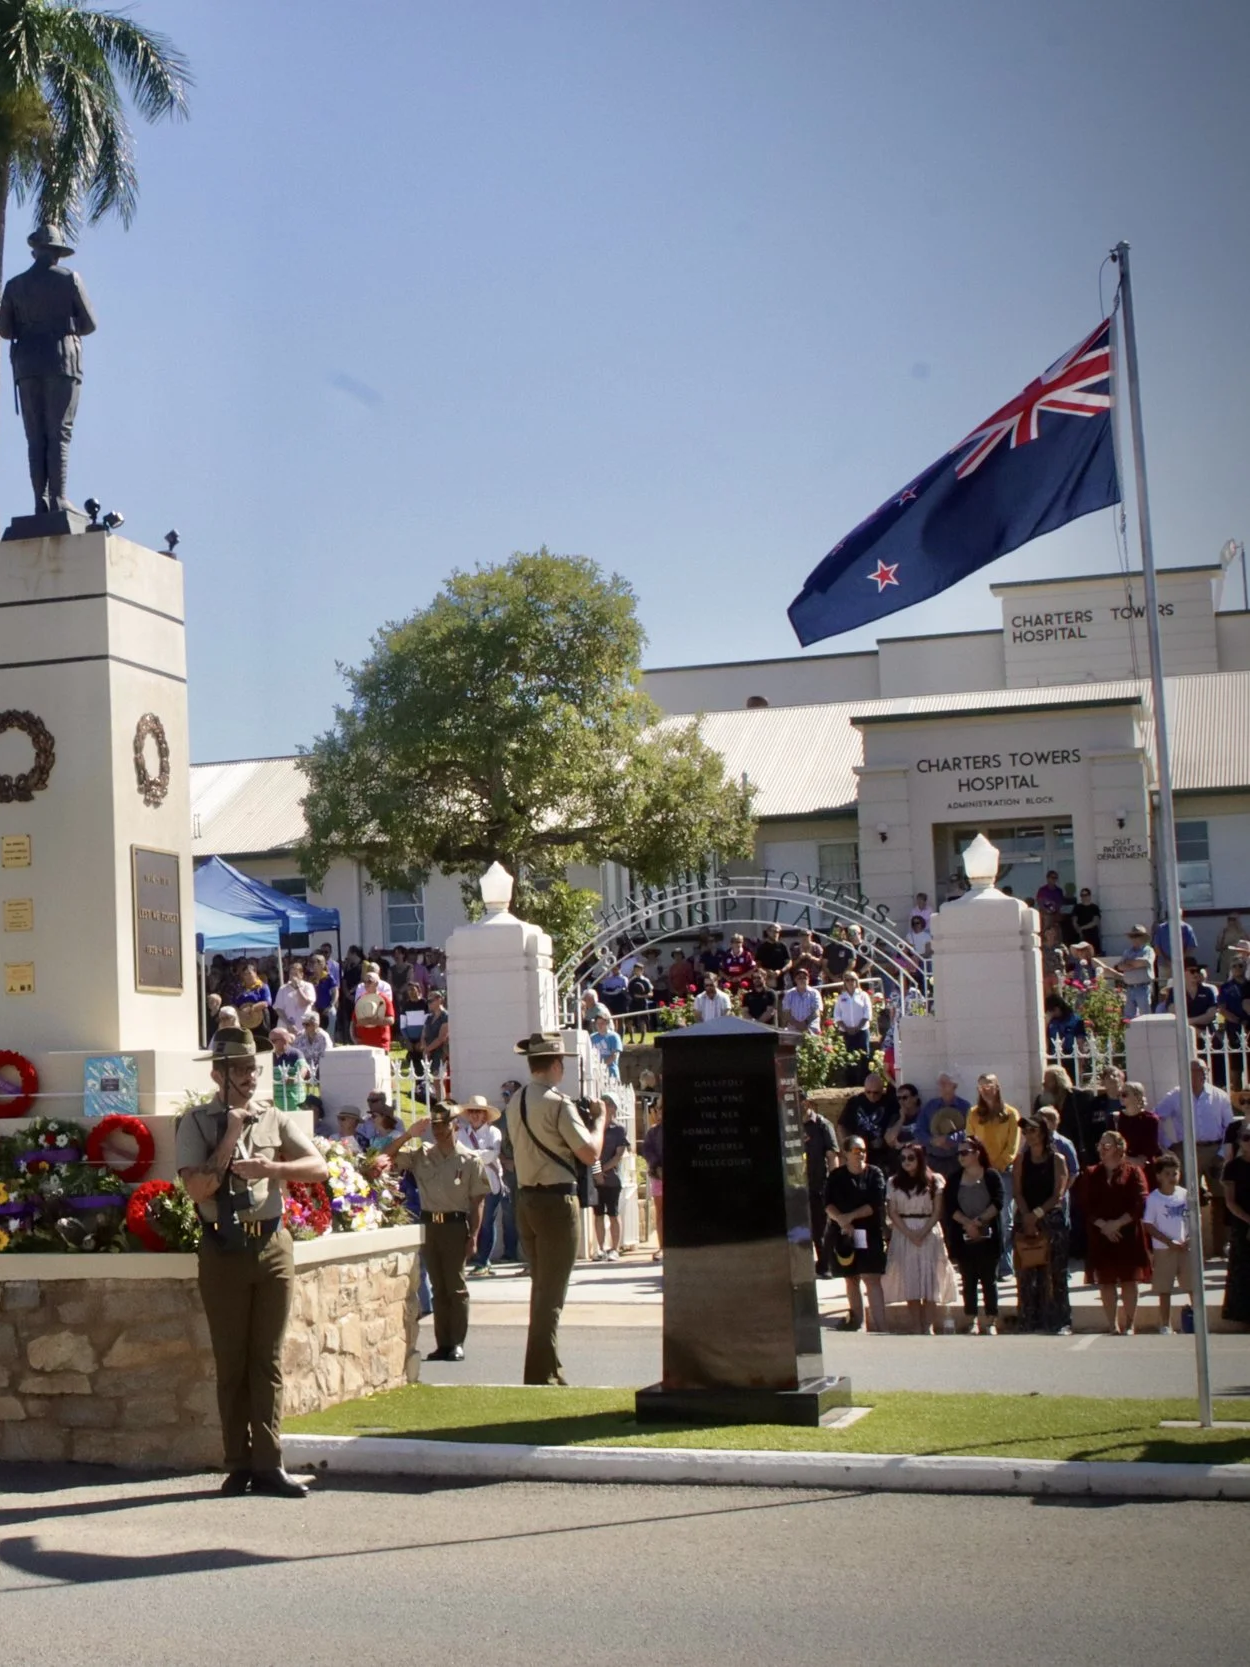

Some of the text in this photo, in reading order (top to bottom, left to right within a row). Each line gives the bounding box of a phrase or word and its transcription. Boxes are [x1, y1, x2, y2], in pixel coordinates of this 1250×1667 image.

[1012, 604, 1174, 627] CHARTERS TOWRS
[1012, 626, 1087, 644] HOSPITAL
[916, 748, 1082, 773] CHARTERS TOWERS
[958, 774, 1040, 793] HOSPITAL
[947, 796, 1054, 810] ADMINISTRATION BLOCK
[1112, 838, 1132, 846] OUT
[1096, 851, 1148, 861] DEPARTMENT
[760, 868, 891, 924] TOWERS
